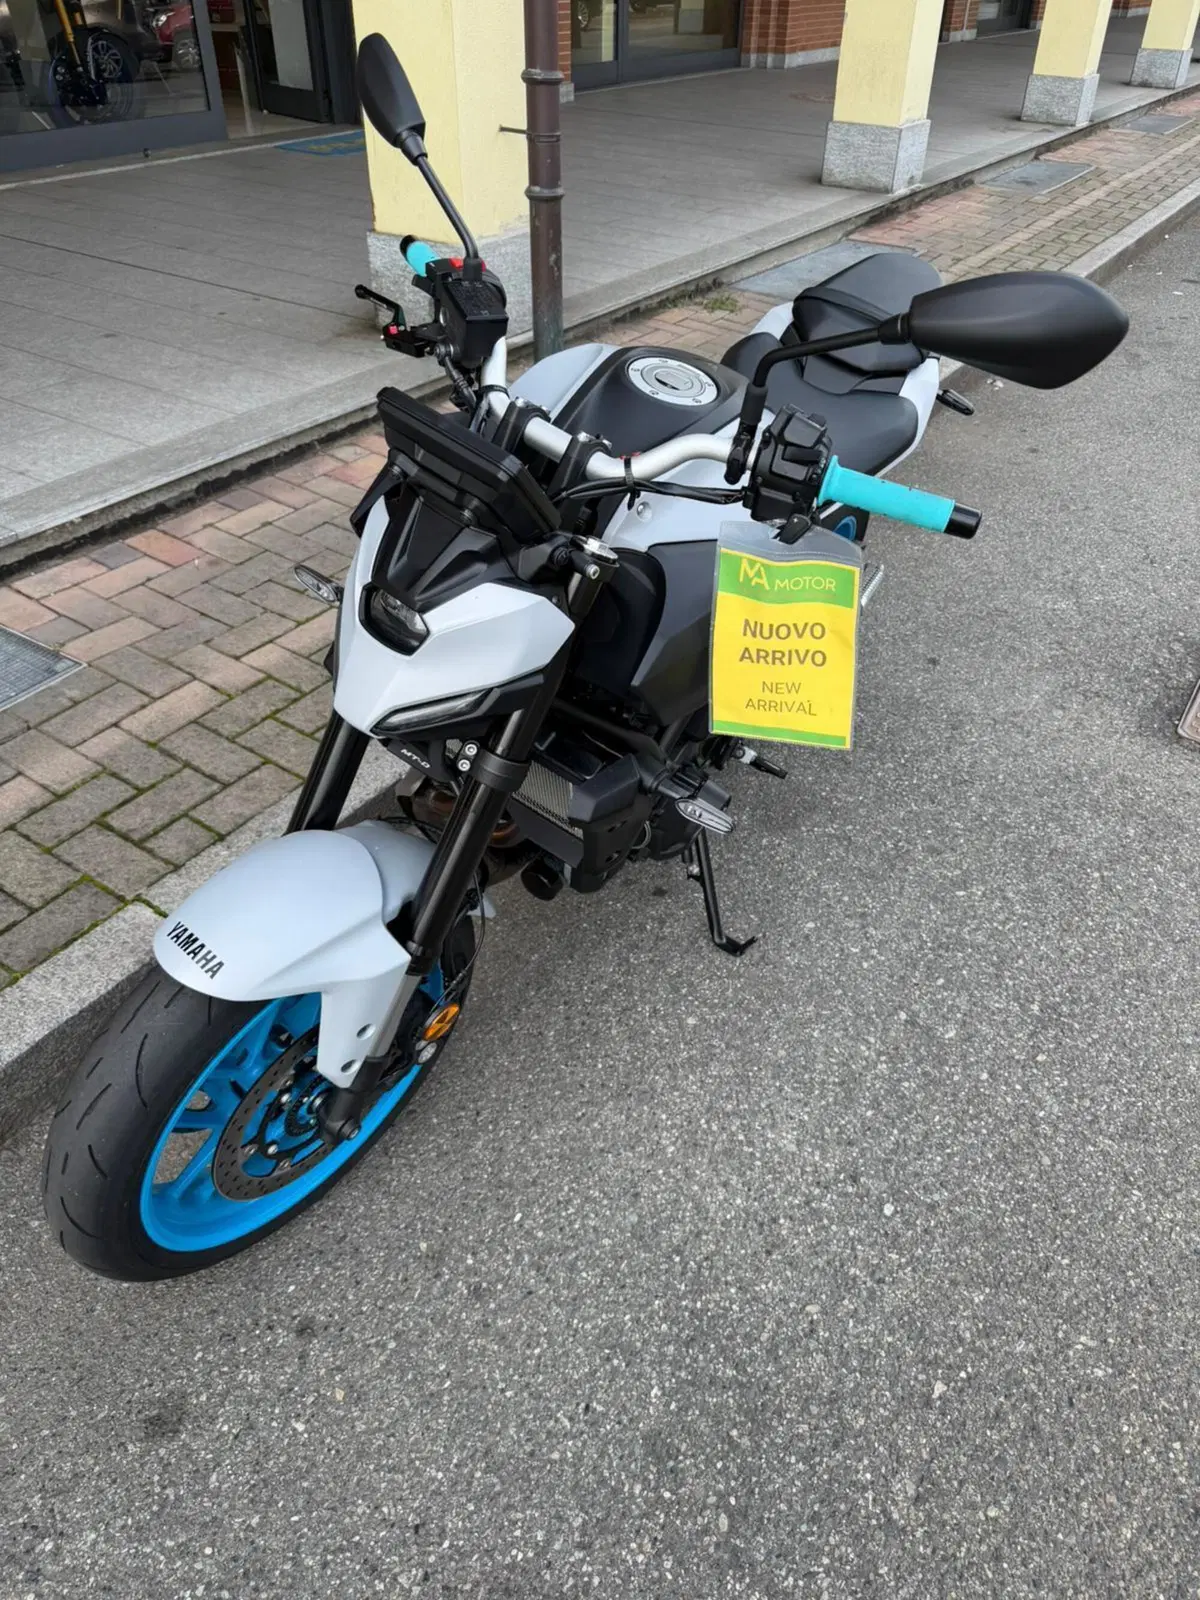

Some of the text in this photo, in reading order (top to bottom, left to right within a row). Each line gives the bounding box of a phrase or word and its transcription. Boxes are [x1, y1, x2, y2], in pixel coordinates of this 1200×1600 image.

[774, 576, 836, 591] MOTOR
[742, 618, 826, 641] NUOVO
[739, 647, 827, 668] ARRIVO
[761, 680, 802, 696] NEW
[745, 699, 817, 716] ARRIVAL
[166, 920, 225, 980] YAMAHA
